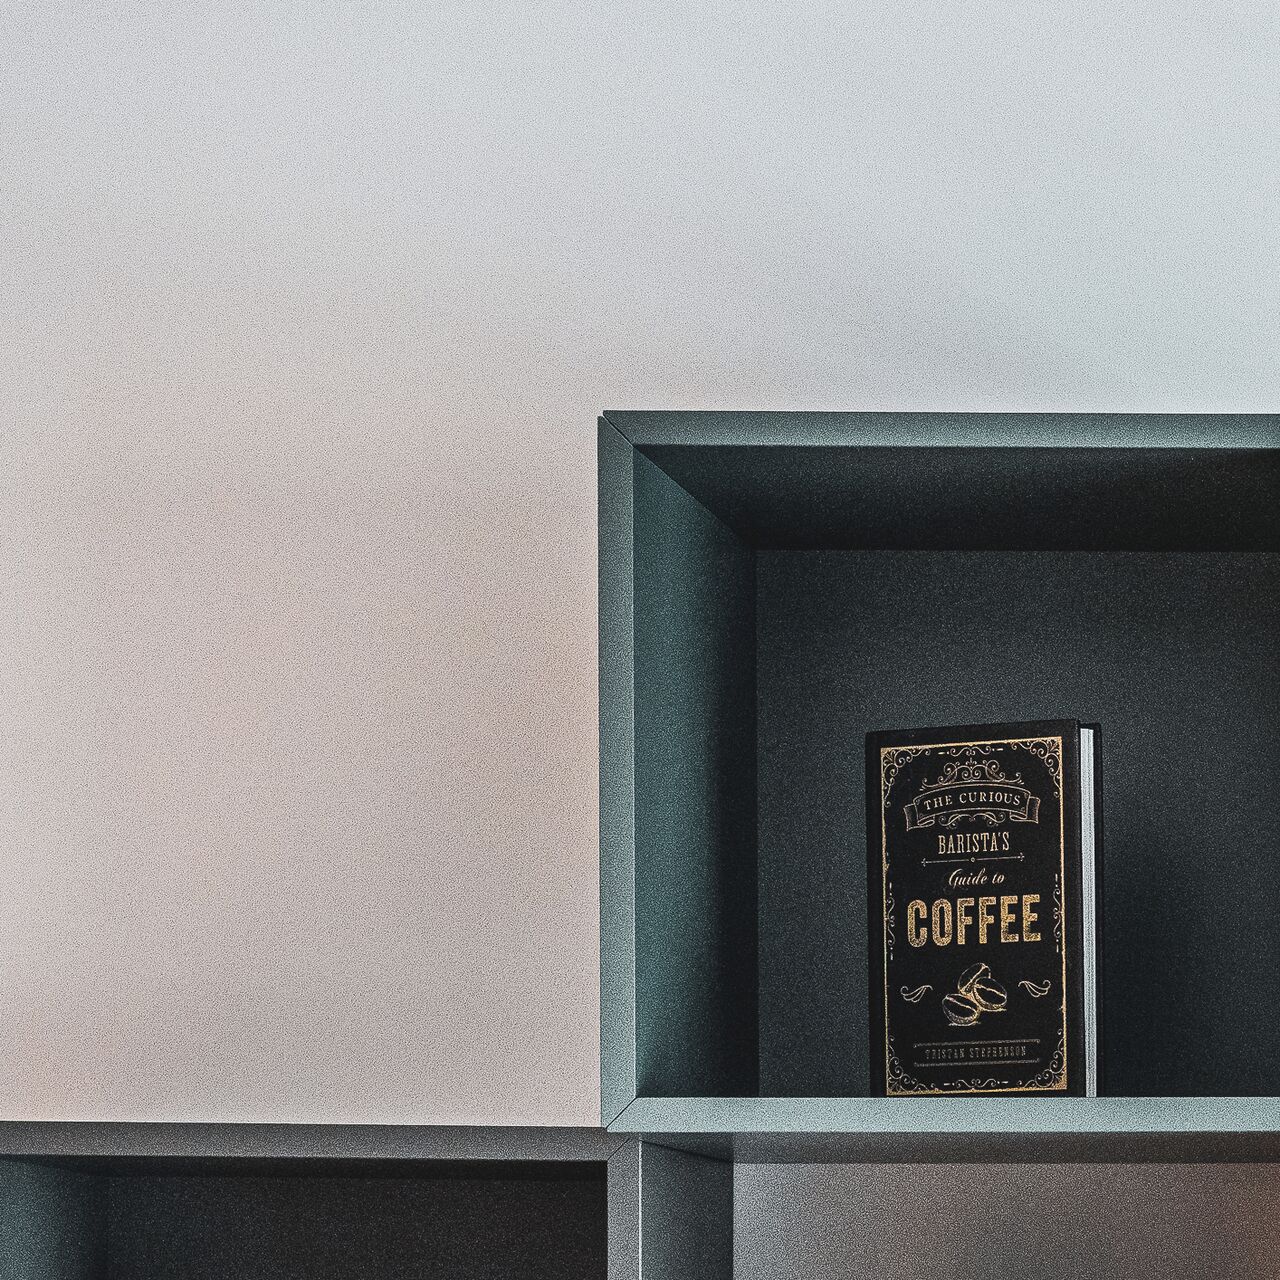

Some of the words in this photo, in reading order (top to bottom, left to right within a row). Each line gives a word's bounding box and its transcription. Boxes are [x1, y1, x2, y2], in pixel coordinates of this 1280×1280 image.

[924, 795, 952, 810] THE
[960, 792, 1020, 806] CURIOUS
[938, 832, 1010, 854] BARISTA'S
[949, 867, 988, 889] Guide
[992, 873, 1005, 885] to
[907, 894, 1041, 948] COFFEE
